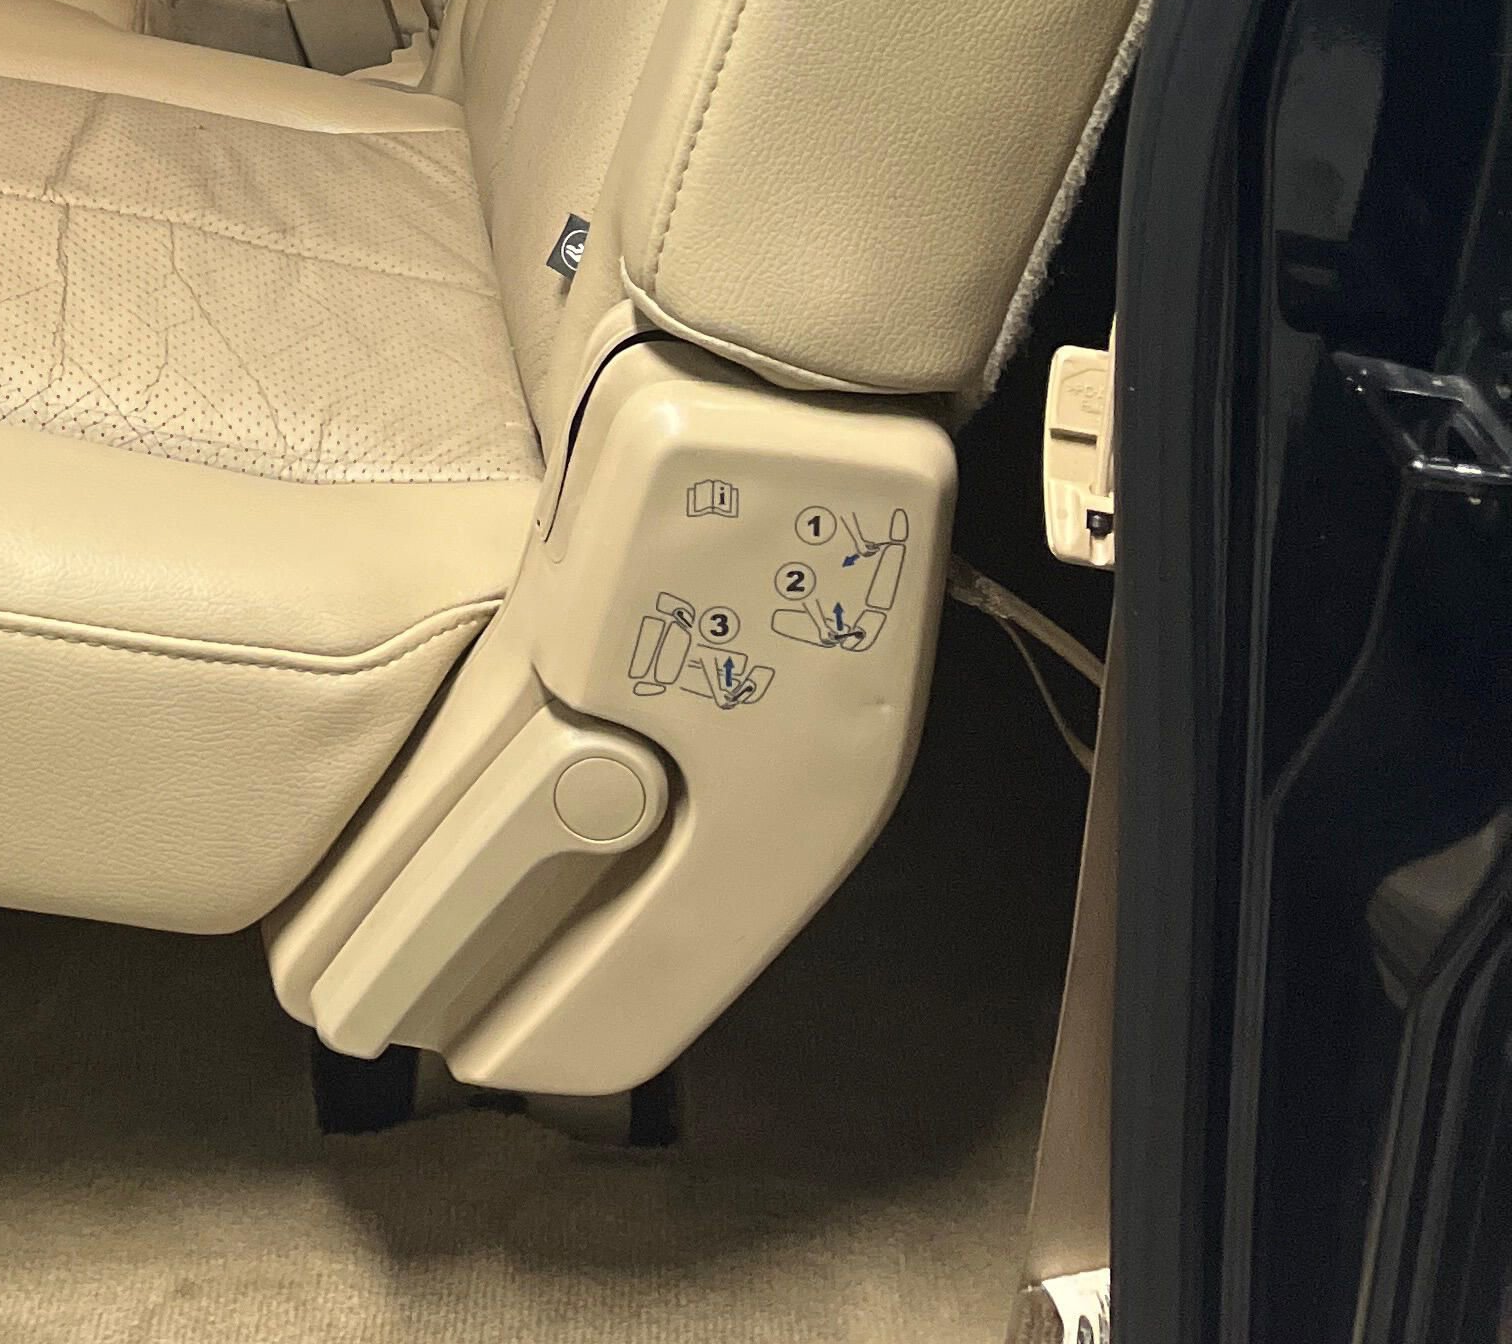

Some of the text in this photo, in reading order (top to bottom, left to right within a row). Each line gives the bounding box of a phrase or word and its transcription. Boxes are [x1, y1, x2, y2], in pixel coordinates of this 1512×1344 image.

[807, 515, 821, 537] 1
[786, 570, 805, 592] 2
[710, 613, 729, 637] 3
